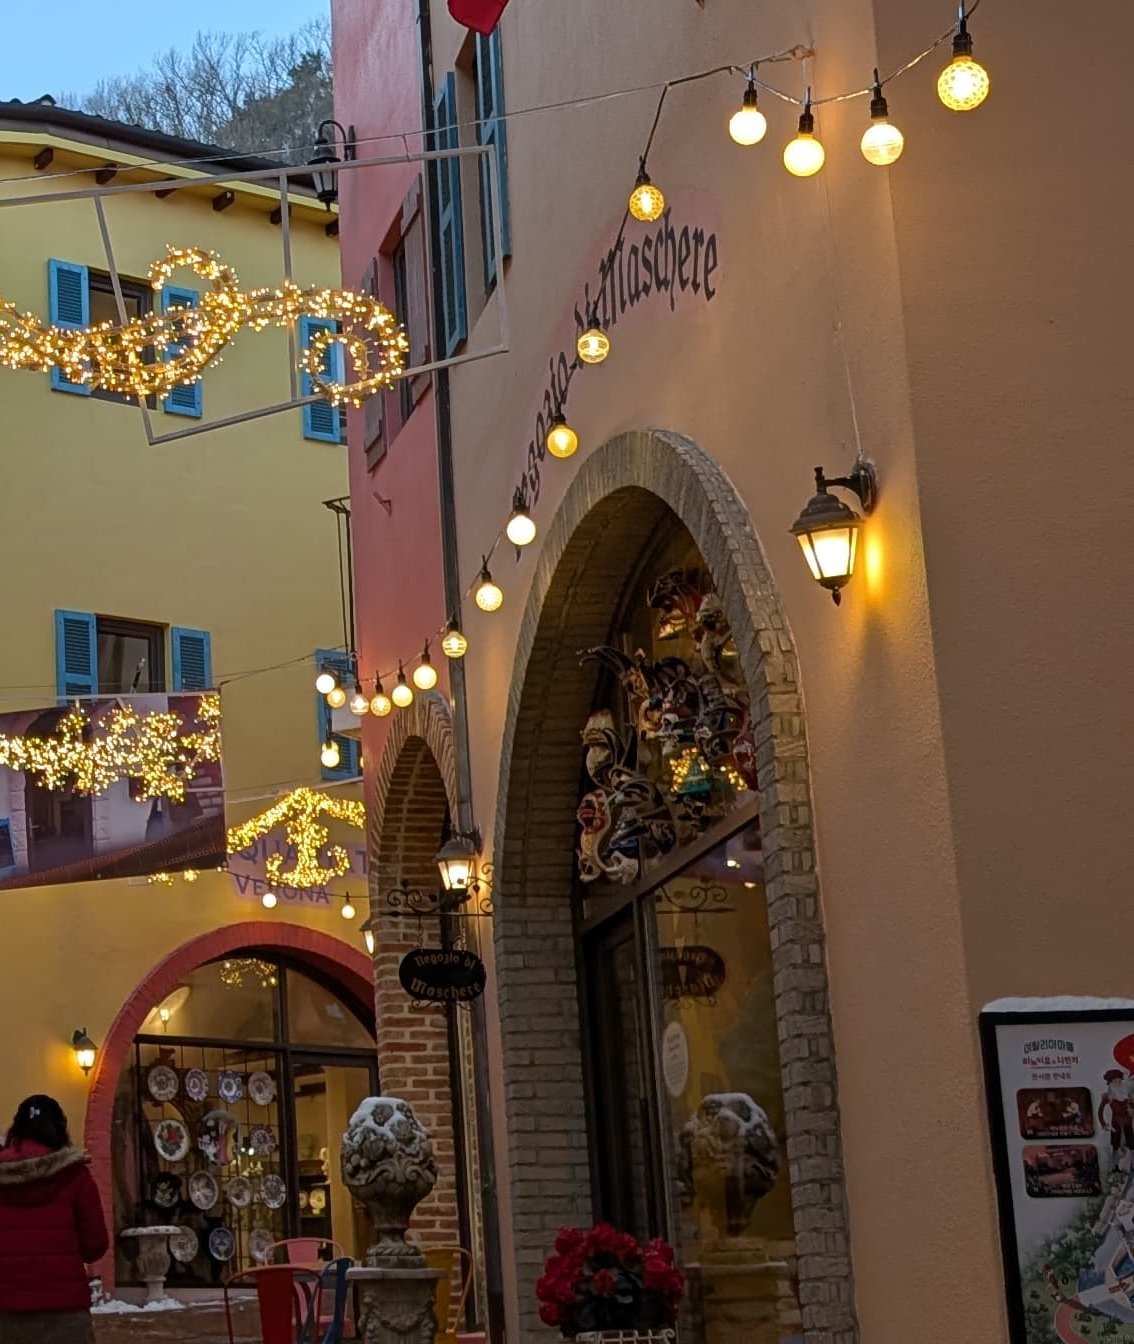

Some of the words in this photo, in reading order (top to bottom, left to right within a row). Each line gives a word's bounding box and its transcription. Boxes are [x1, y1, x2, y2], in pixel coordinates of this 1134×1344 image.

[598, 206, 718, 331] Maschere
[235, 874, 330, 904] VEONA
[411, 977, 481, 999] Maschere
